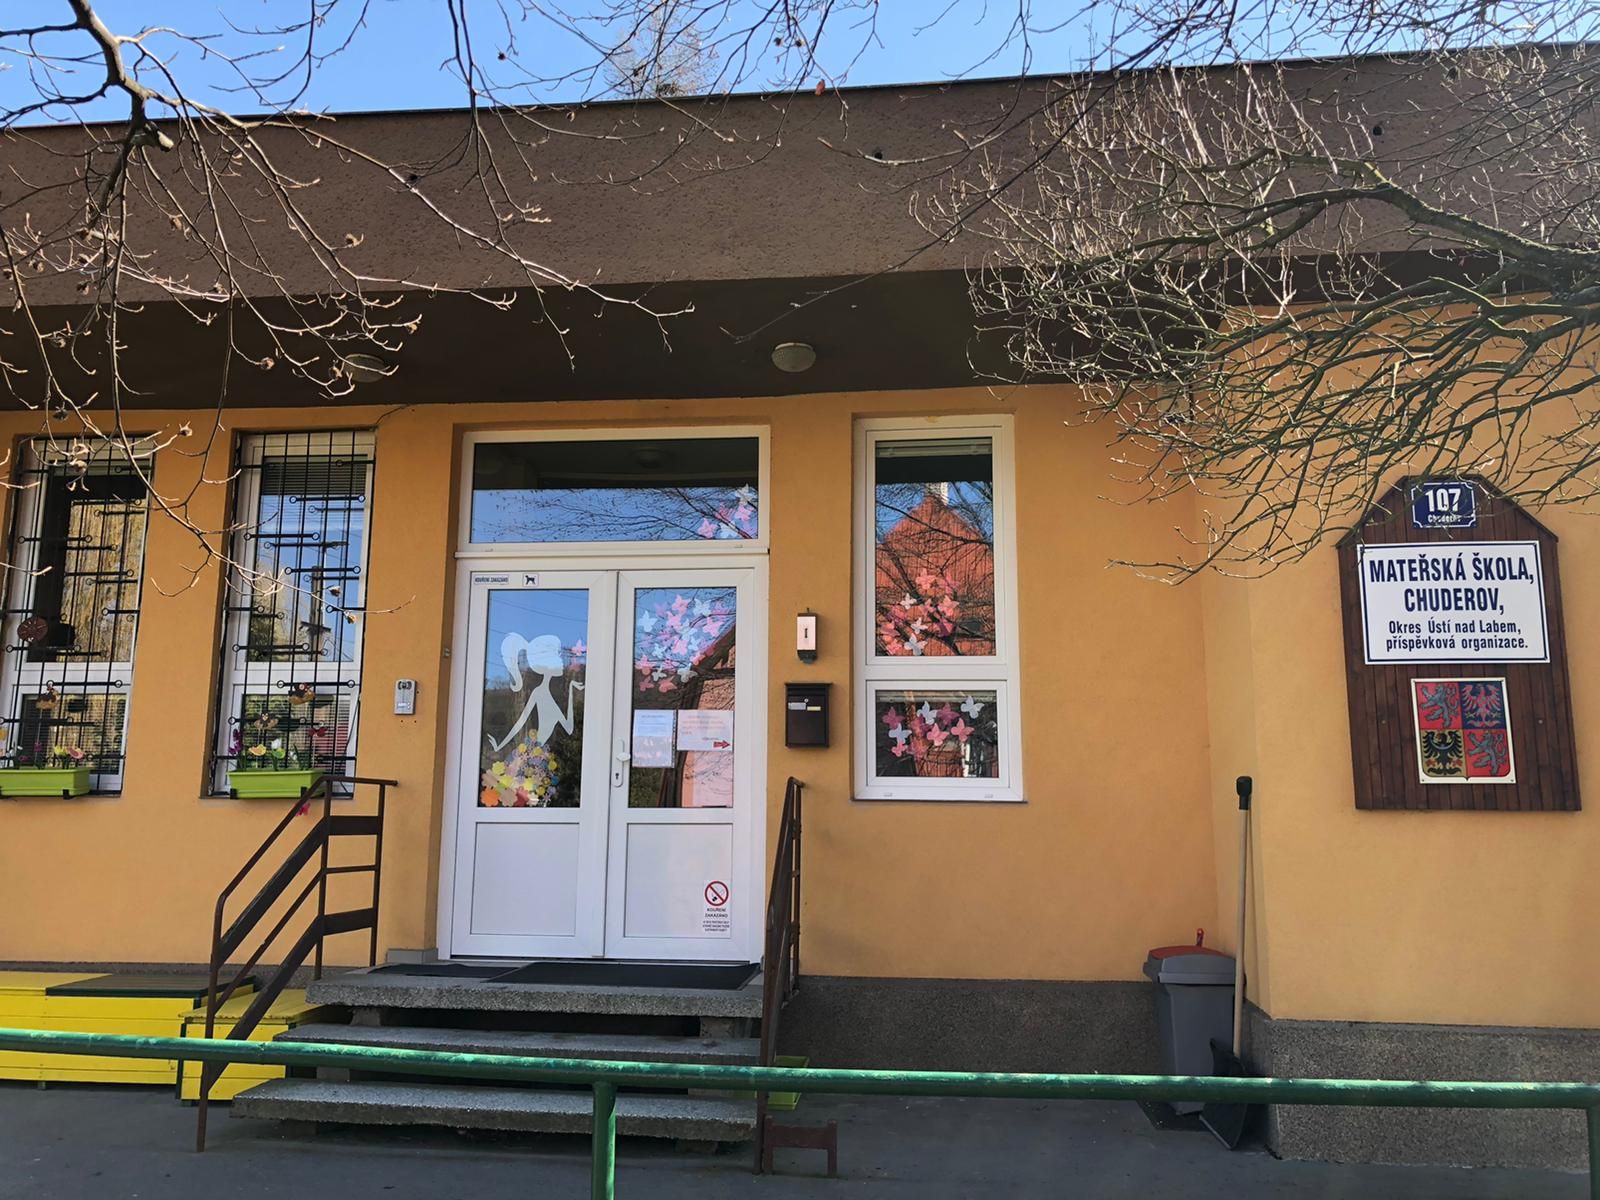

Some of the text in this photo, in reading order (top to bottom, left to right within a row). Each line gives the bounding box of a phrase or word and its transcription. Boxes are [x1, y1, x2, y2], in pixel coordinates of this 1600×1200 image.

[1425, 488, 1461, 512] 107
[1369, 552, 1534, 584] MATEŘSKÁ ŠKOLA,
[1404, 588, 1504, 615] CHUDEROV,
[1389, 617, 1521, 635] Okres Ústí nad Labem,
[1386, 634, 1528, 652] příspěvková organizace.
